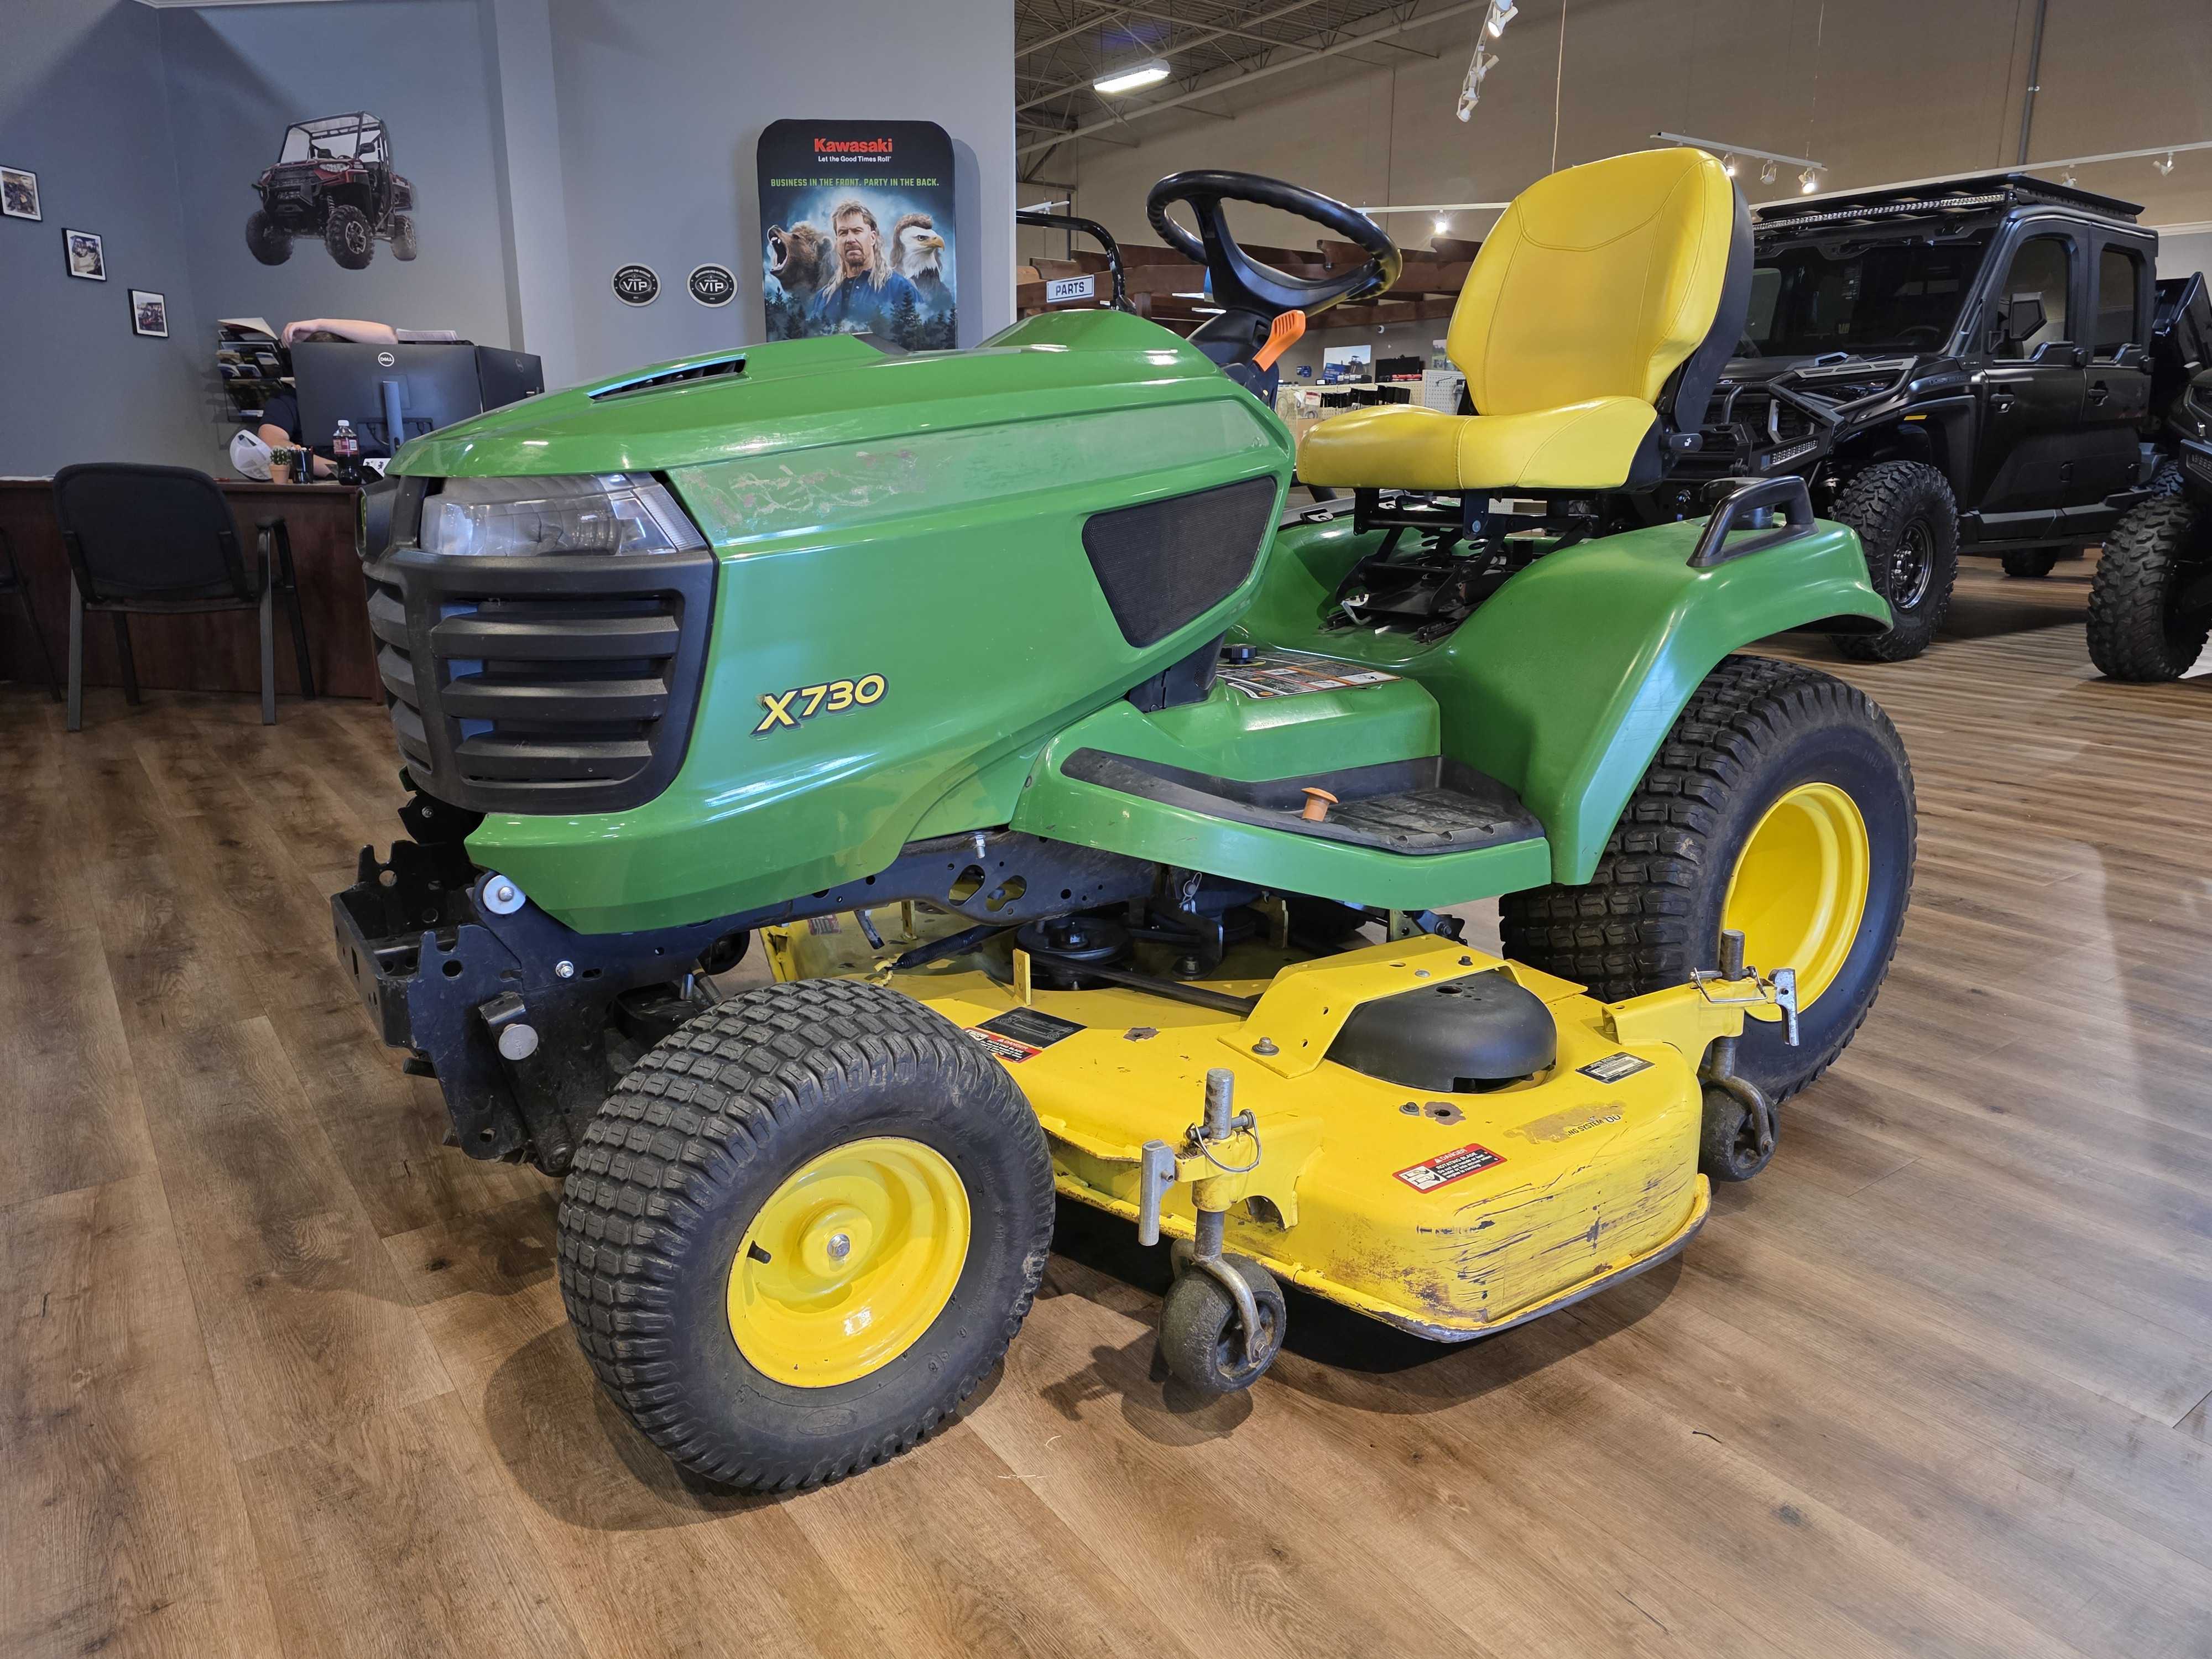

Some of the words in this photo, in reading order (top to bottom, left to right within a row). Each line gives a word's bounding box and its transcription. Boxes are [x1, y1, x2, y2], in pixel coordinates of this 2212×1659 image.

[814, 138, 893, 153] Kawasaki
[623, 281, 647, 291] VIP
[699, 282, 724, 291] VIP
[1056, 281, 1084, 296] PARTS
[751, 673, 889, 735] X730
[1439, 1149, 1468, 1161] DANGER
